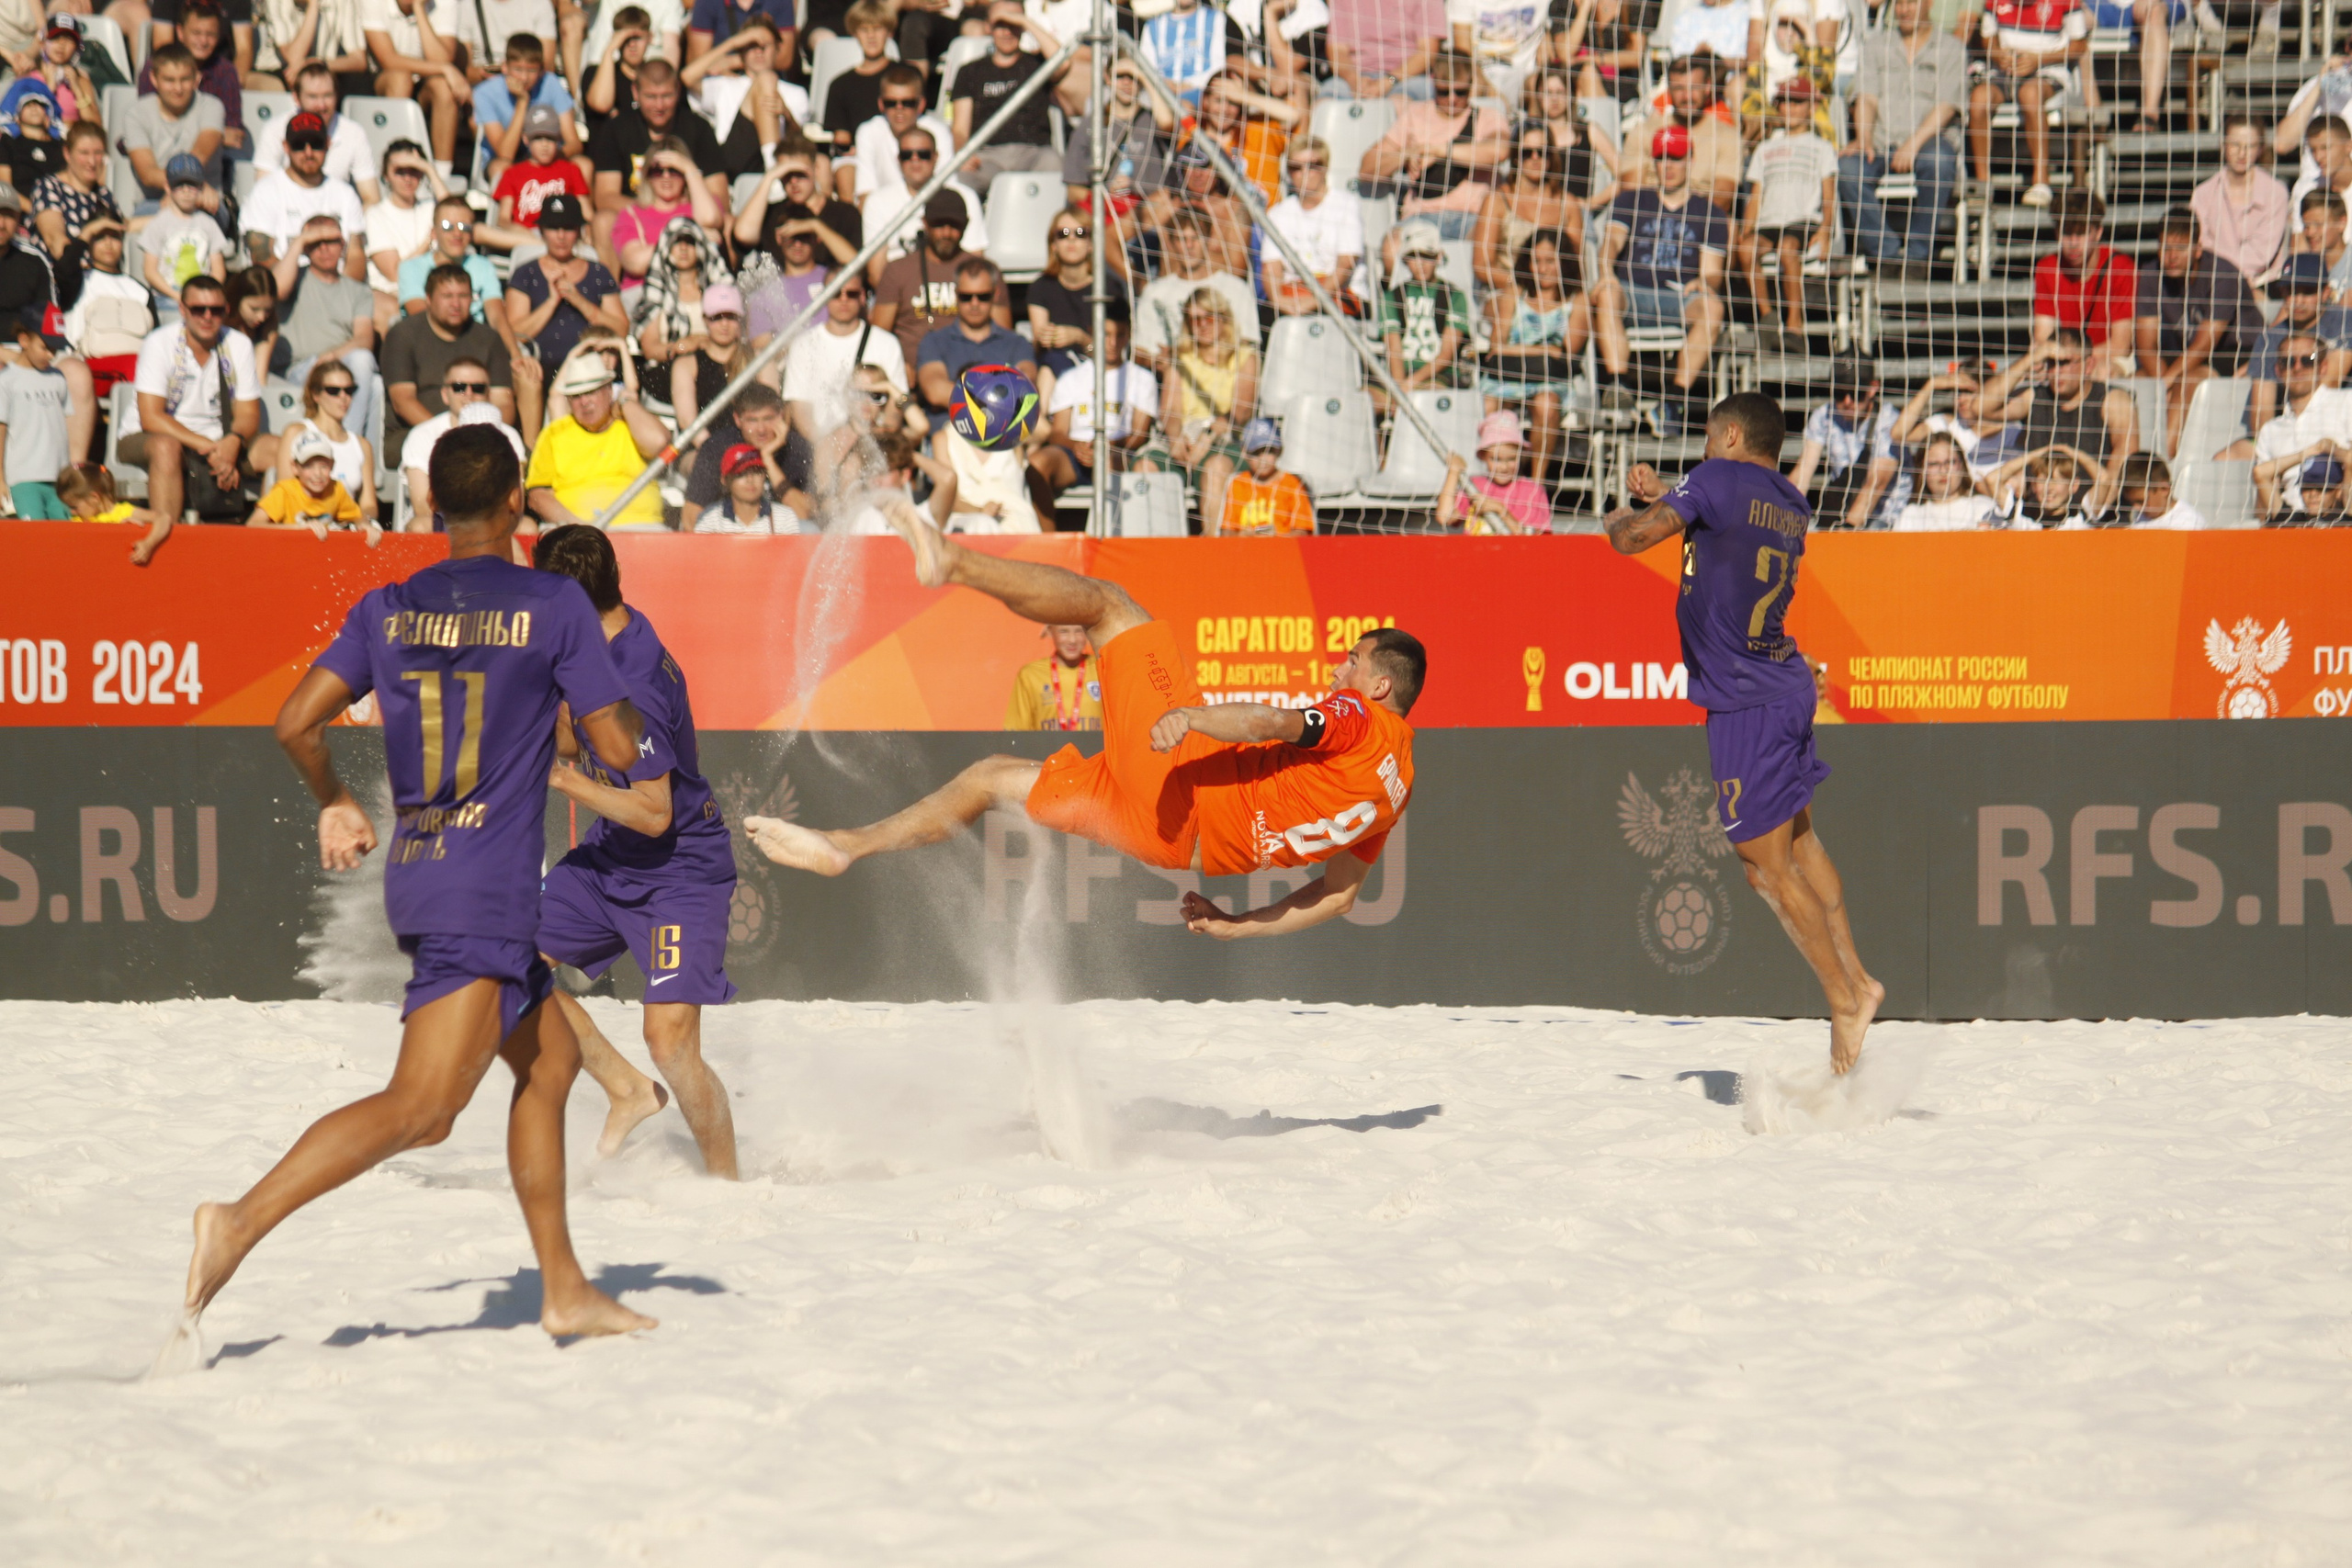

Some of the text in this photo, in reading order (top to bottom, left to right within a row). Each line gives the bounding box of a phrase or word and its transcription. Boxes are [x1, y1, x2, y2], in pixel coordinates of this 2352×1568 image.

[1197, 616, 1314, 653] САРАТОВ
[92, 639, 203, 705] 2024
[1196, 660, 1221, 686] 30
[1226, 664, 1288, 686] АВГУСТА
[1308, 659, 1318, 685] 1
[1849, 656, 2028, 682] ЧЕМПИОНАТ РОССИИ
[1849, 684, 2069, 709] ПО ПЛЯЖНОМУ ФУТБОЛУ
[401, 671, 486, 802] 11
[1285, 800, 1377, 856] 8
